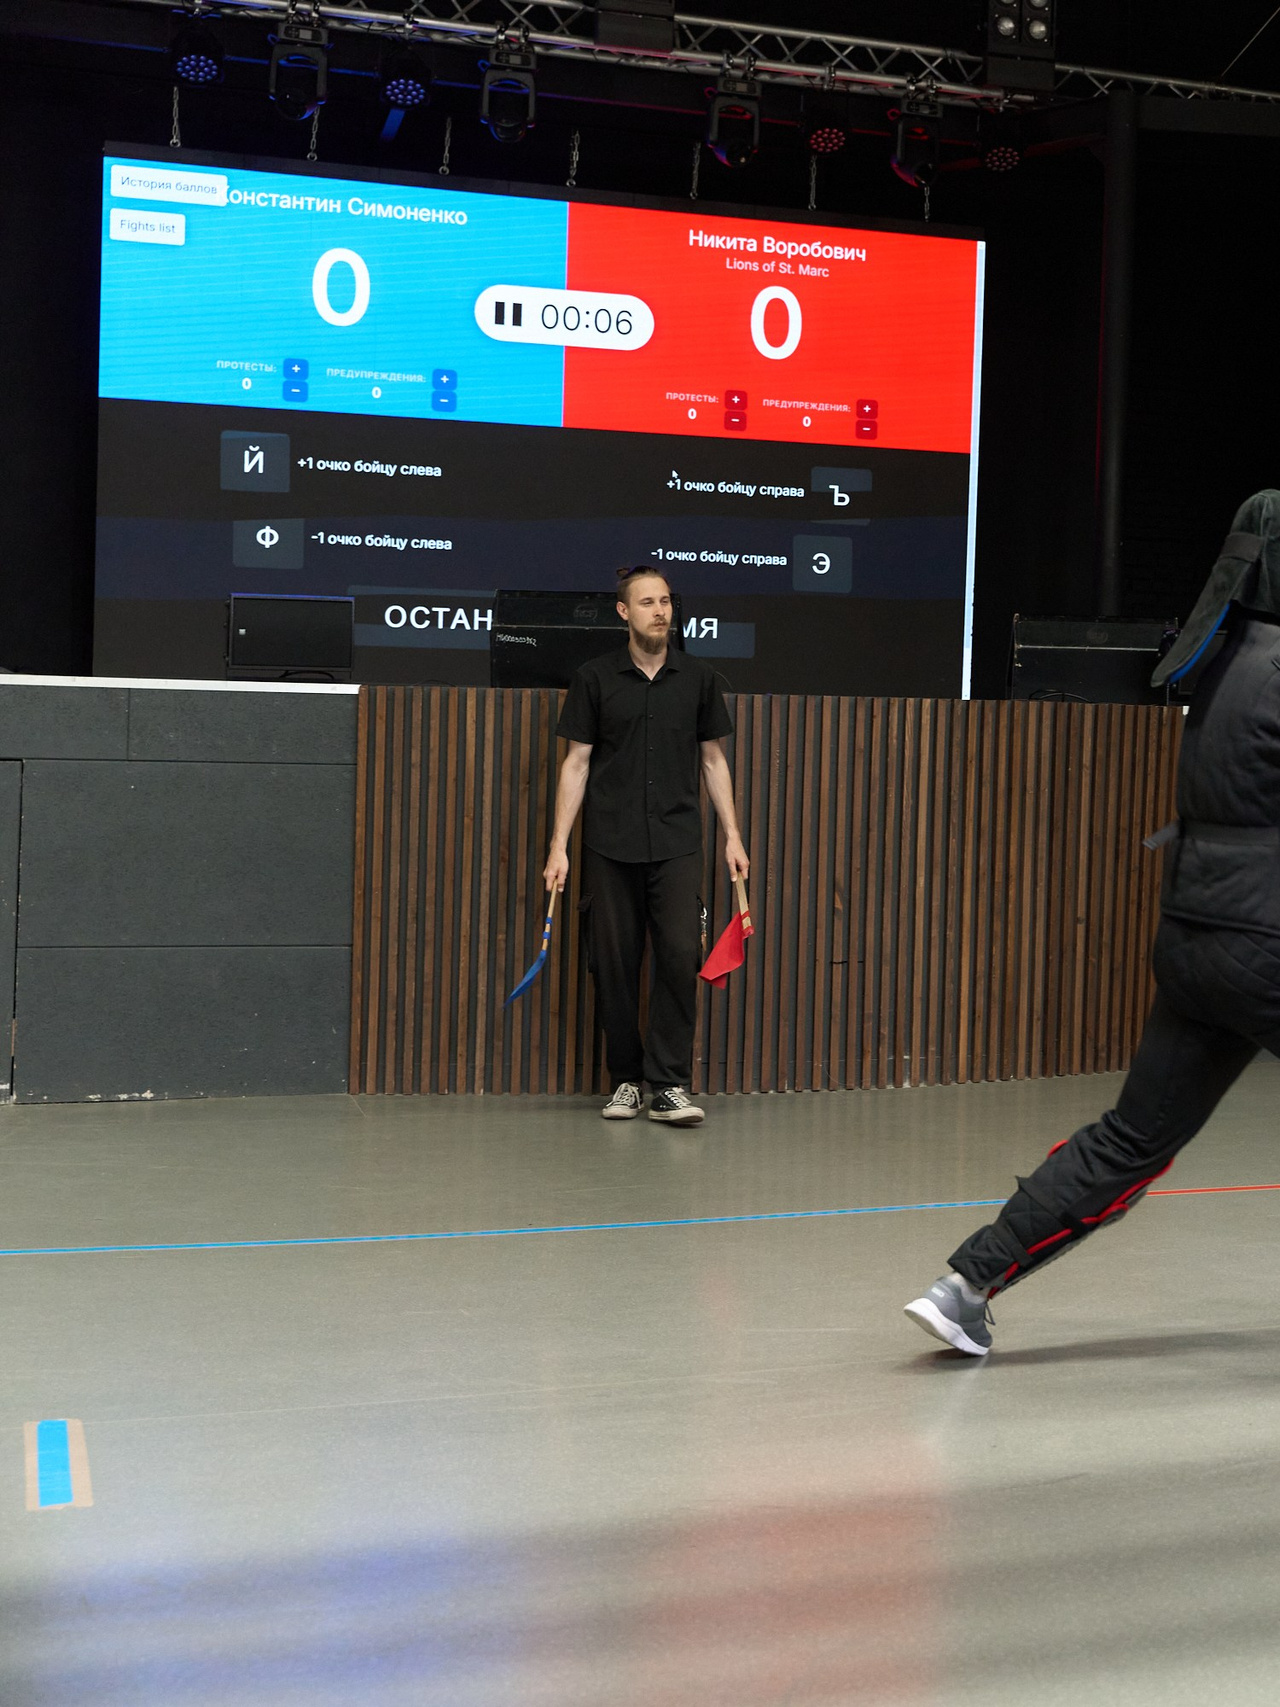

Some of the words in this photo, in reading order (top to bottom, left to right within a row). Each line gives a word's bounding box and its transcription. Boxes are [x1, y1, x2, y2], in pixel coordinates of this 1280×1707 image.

[121, 176, 172, 191] История
[175, 181, 217, 194] баллов
[347, 197, 468, 226] Симоненко
[120, 219, 156, 236] Fights
[159, 222, 176, 234] list
[688, 229, 758, 252] Никита
[764, 236, 867, 263] Воробович
[725, 257, 760, 272] Lions
[762, 260, 776, 273] of
[778, 261, 795, 275] St.
[798, 263, 830, 278] Marc
[311, 247, 371, 327] 0
[541, 304, 633, 336] 00:06
[750, 285, 803, 360] 0
[241, 377, 253, 391] 0
[371, 386, 382, 399] 0
[665, 392, 719, 403] ПРОТЕСТЫ:
[762, 398, 851, 412] ПРЕДУПРЕЖДЕНИЯ:
[687, 407, 697, 420] 0
[802, 415, 812, 428] 0
[243, 445, 264, 474] Й
[297, 456, 314, 470] +1
[316, 459, 352, 472] очко
[353, 459, 398, 477] бойцу
[399, 464, 442, 477] слева
[667, 478, 681, 491] +1
[683, 481, 715, 493] очко
[717, 481, 757, 498] бойцу
[759, 485, 805, 499] справа
[828, 484, 850, 506] Ъ
[256, 525, 280, 549] Ф
[310, 531, 325, 544] -1
[327, 534, 362, 546] очко
[364, 534, 409, 551] бойцу
[410, 538, 453, 551] слева
[650, 548, 663, 560] -1
[665, 550, 698, 562] очко
[699, 550, 740, 566] бойцу
[741, 554, 788, 568] справа
[812, 552, 831, 575] Э
[384, 605, 493, 631] ОСТАН
